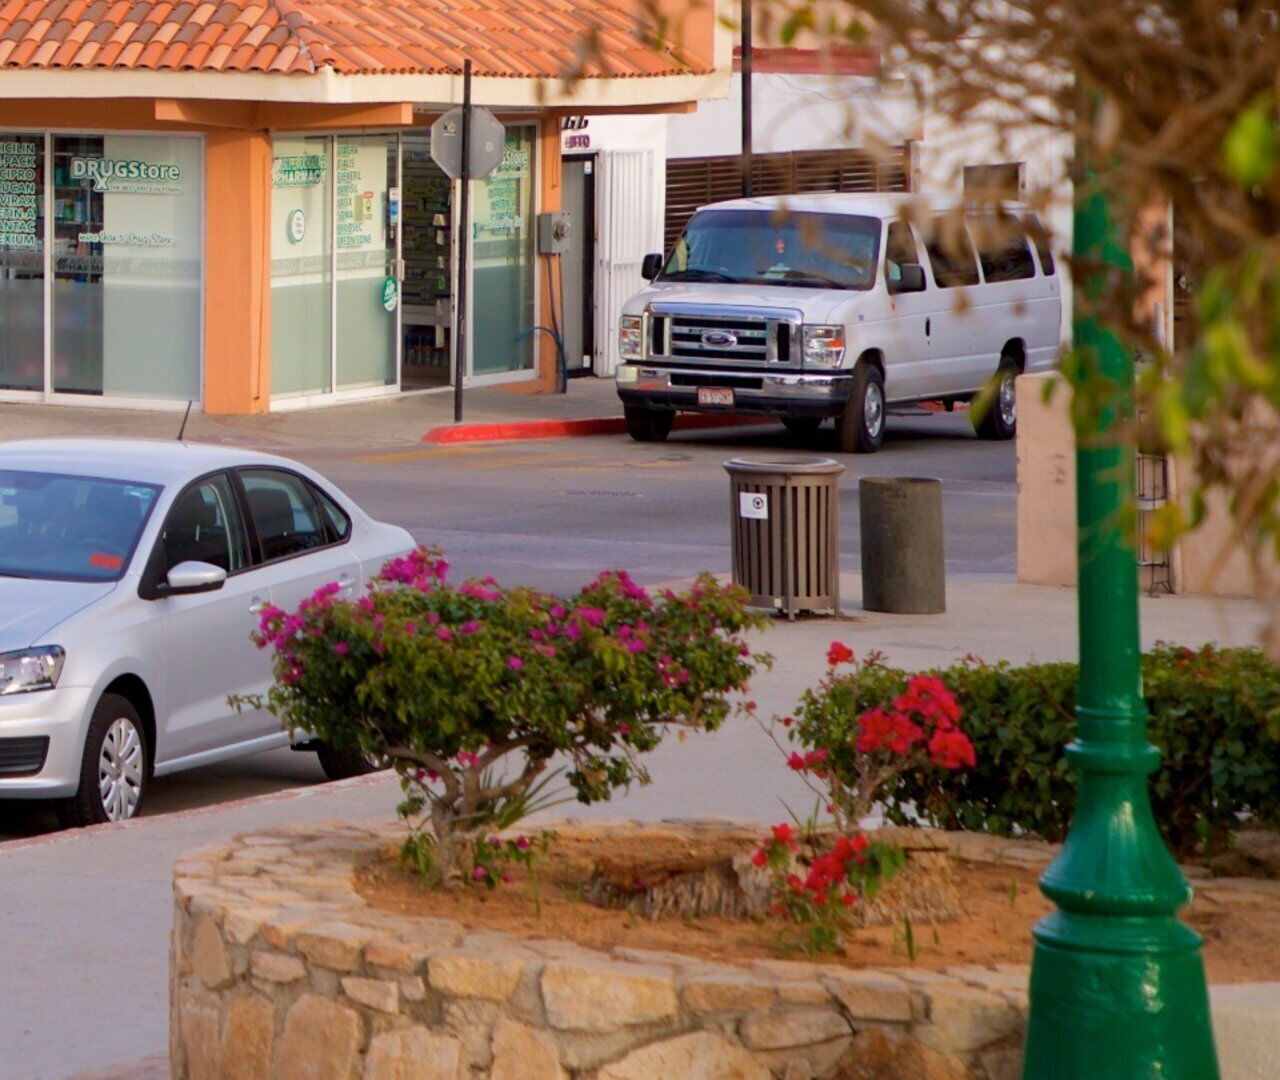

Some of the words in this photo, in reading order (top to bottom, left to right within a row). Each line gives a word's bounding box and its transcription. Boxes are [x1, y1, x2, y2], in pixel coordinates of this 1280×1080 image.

[4, 156, 36, 167] PACK
[0, 169, 36, 180] CIPRO
[73, 159, 181, 189] DRUGStore
